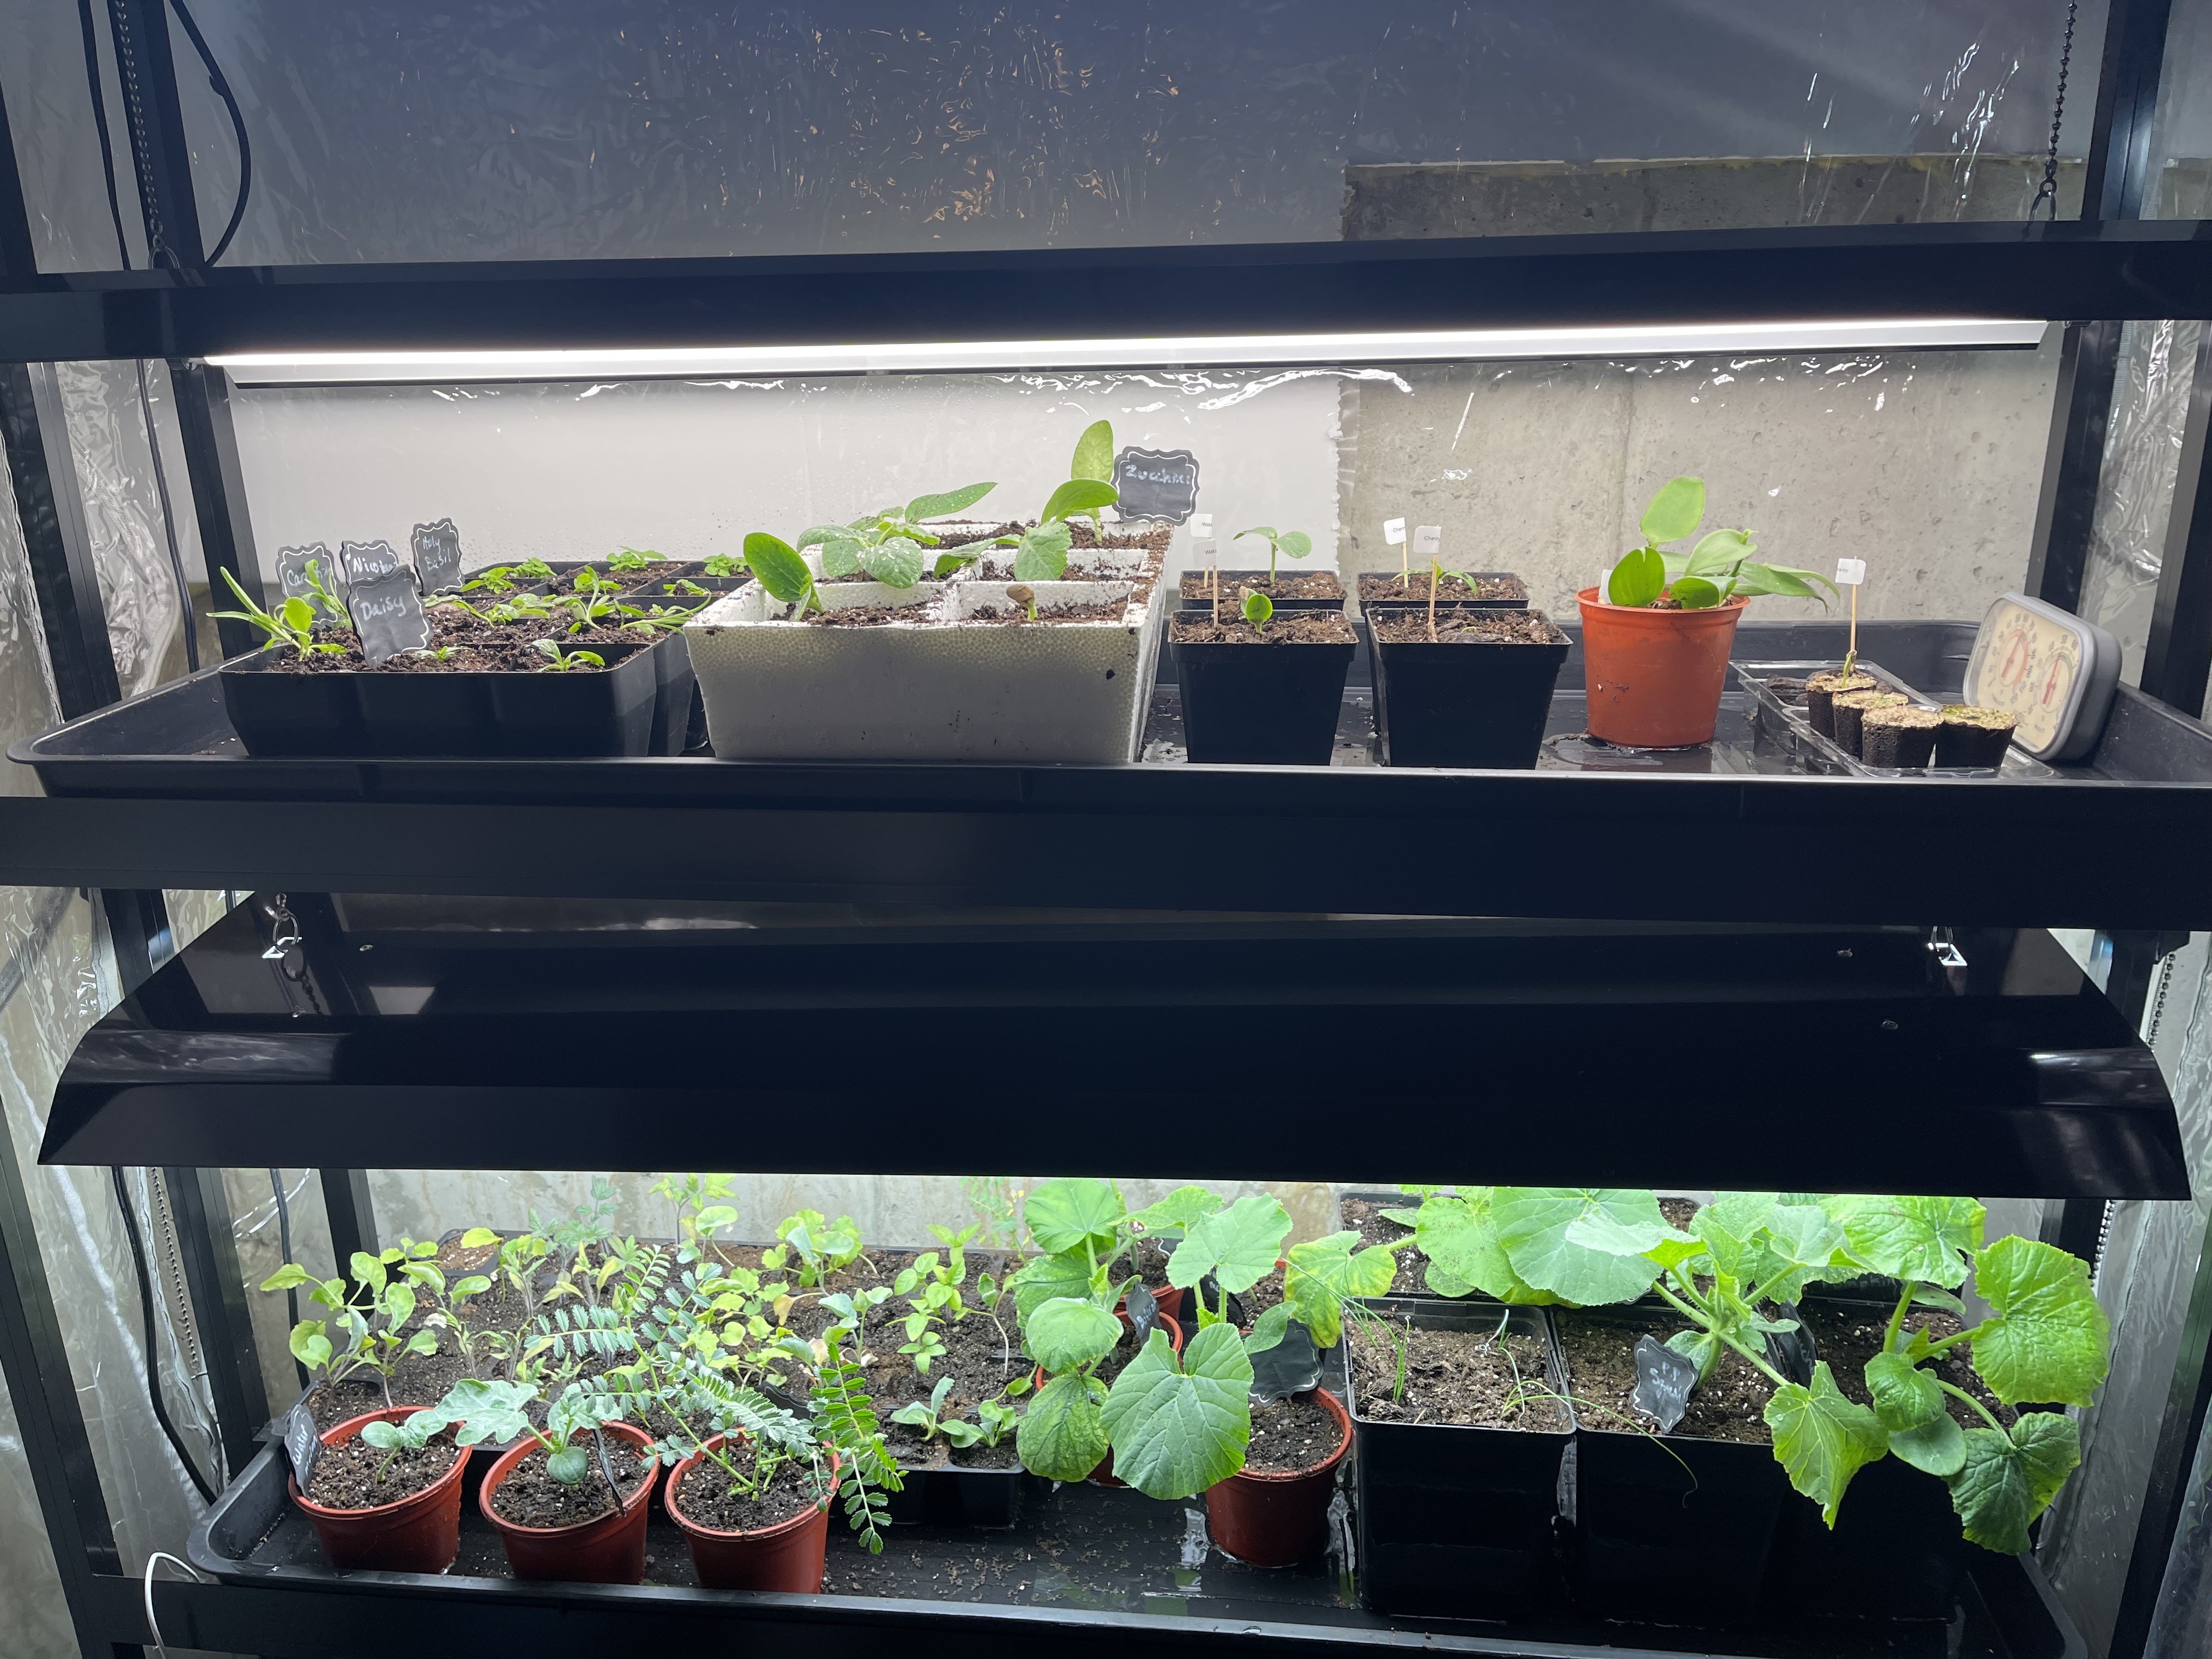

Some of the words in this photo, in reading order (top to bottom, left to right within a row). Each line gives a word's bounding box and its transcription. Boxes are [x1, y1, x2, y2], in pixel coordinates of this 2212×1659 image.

[422, 535, 441, 556] Holy
[424, 546, 452, 572] Basil
[360, 596, 407, 622] Daisy
